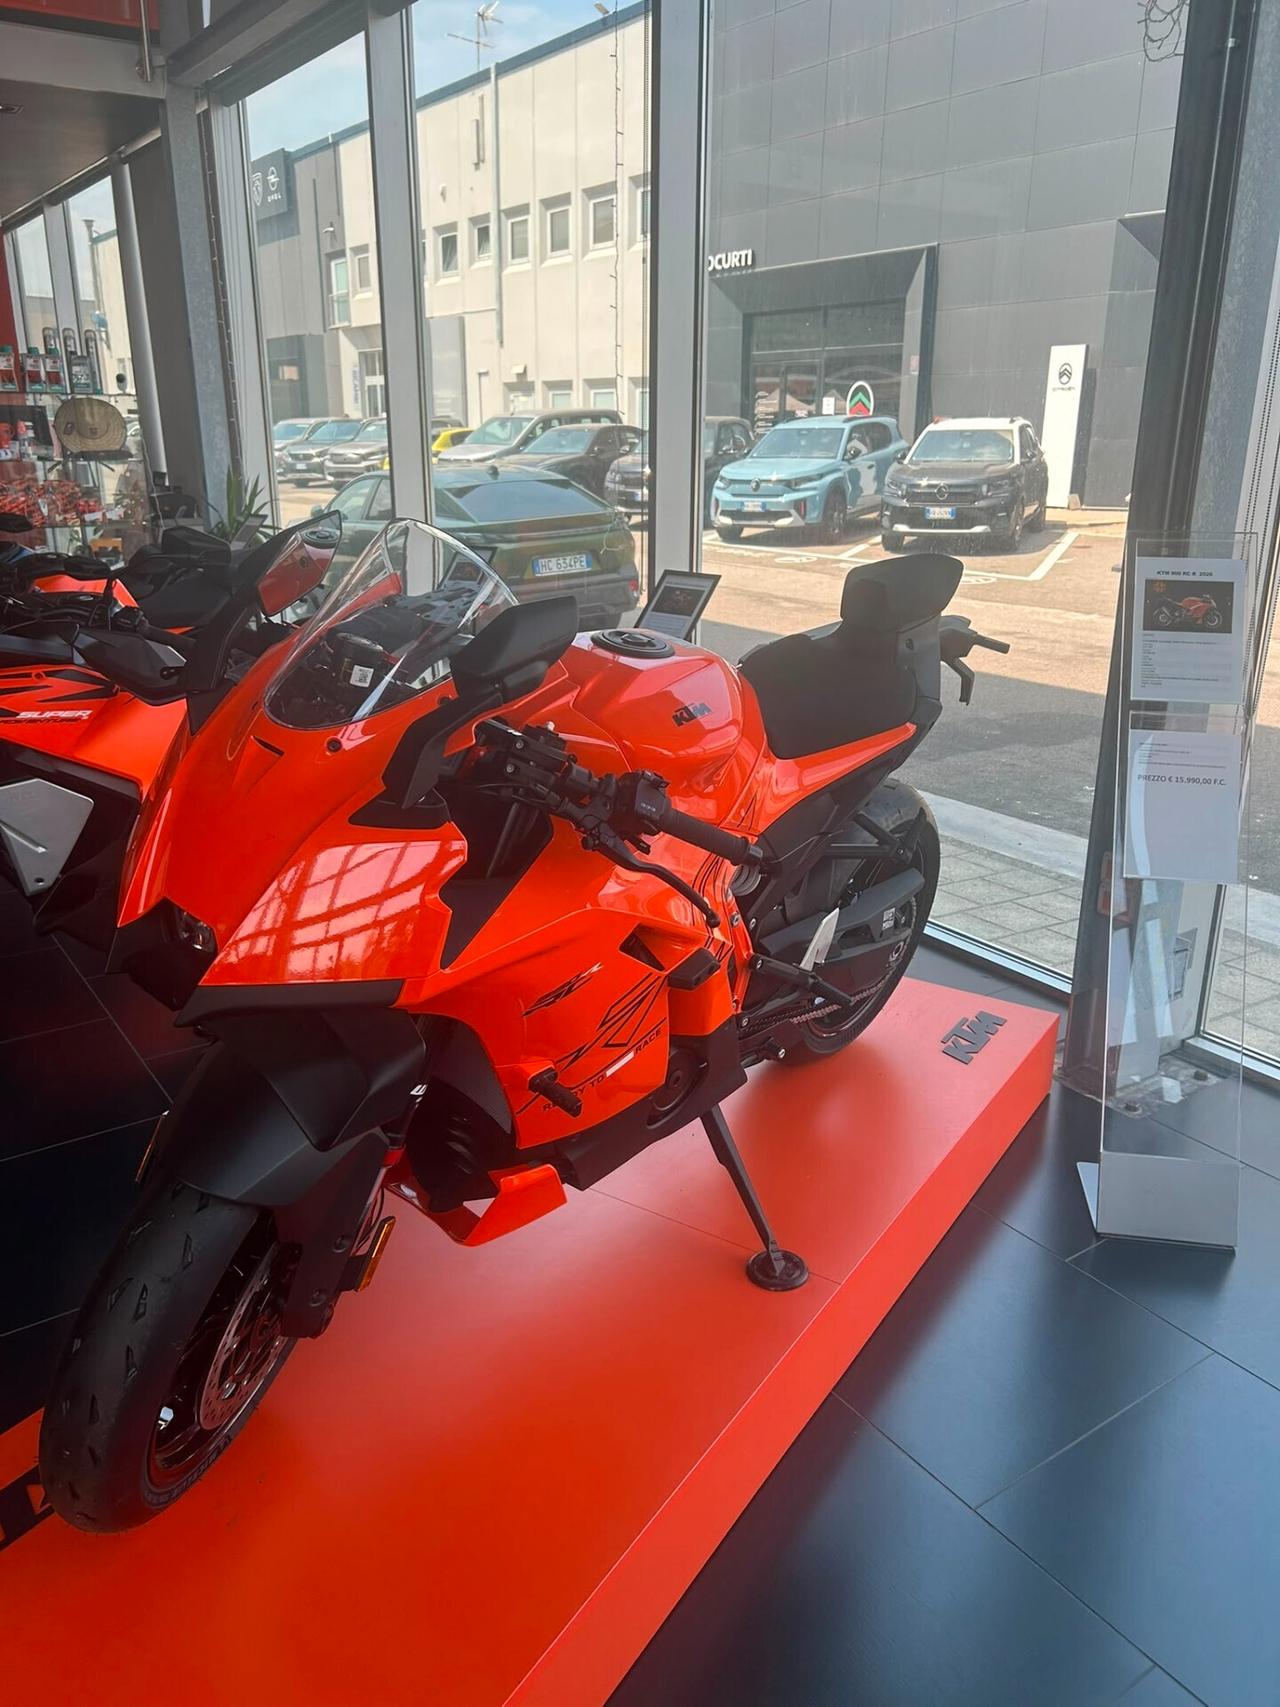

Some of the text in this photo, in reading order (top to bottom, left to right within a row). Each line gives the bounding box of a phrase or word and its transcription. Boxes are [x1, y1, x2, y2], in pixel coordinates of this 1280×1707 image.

[541, 559, 553, 572] HC
[16, 710, 93, 719] SUPER
[672, 703, 712, 727] KTM
[1137, 774, 1167, 783] PREZZO
[1168, 775, 1174, 783] €
[1175, 776, 1212, 786] 15.990,00
[940, 1010, 1008, 1066] KTM
[590, 1074, 606, 1088] TO
[635, 1028, 662, 1055] RACE
